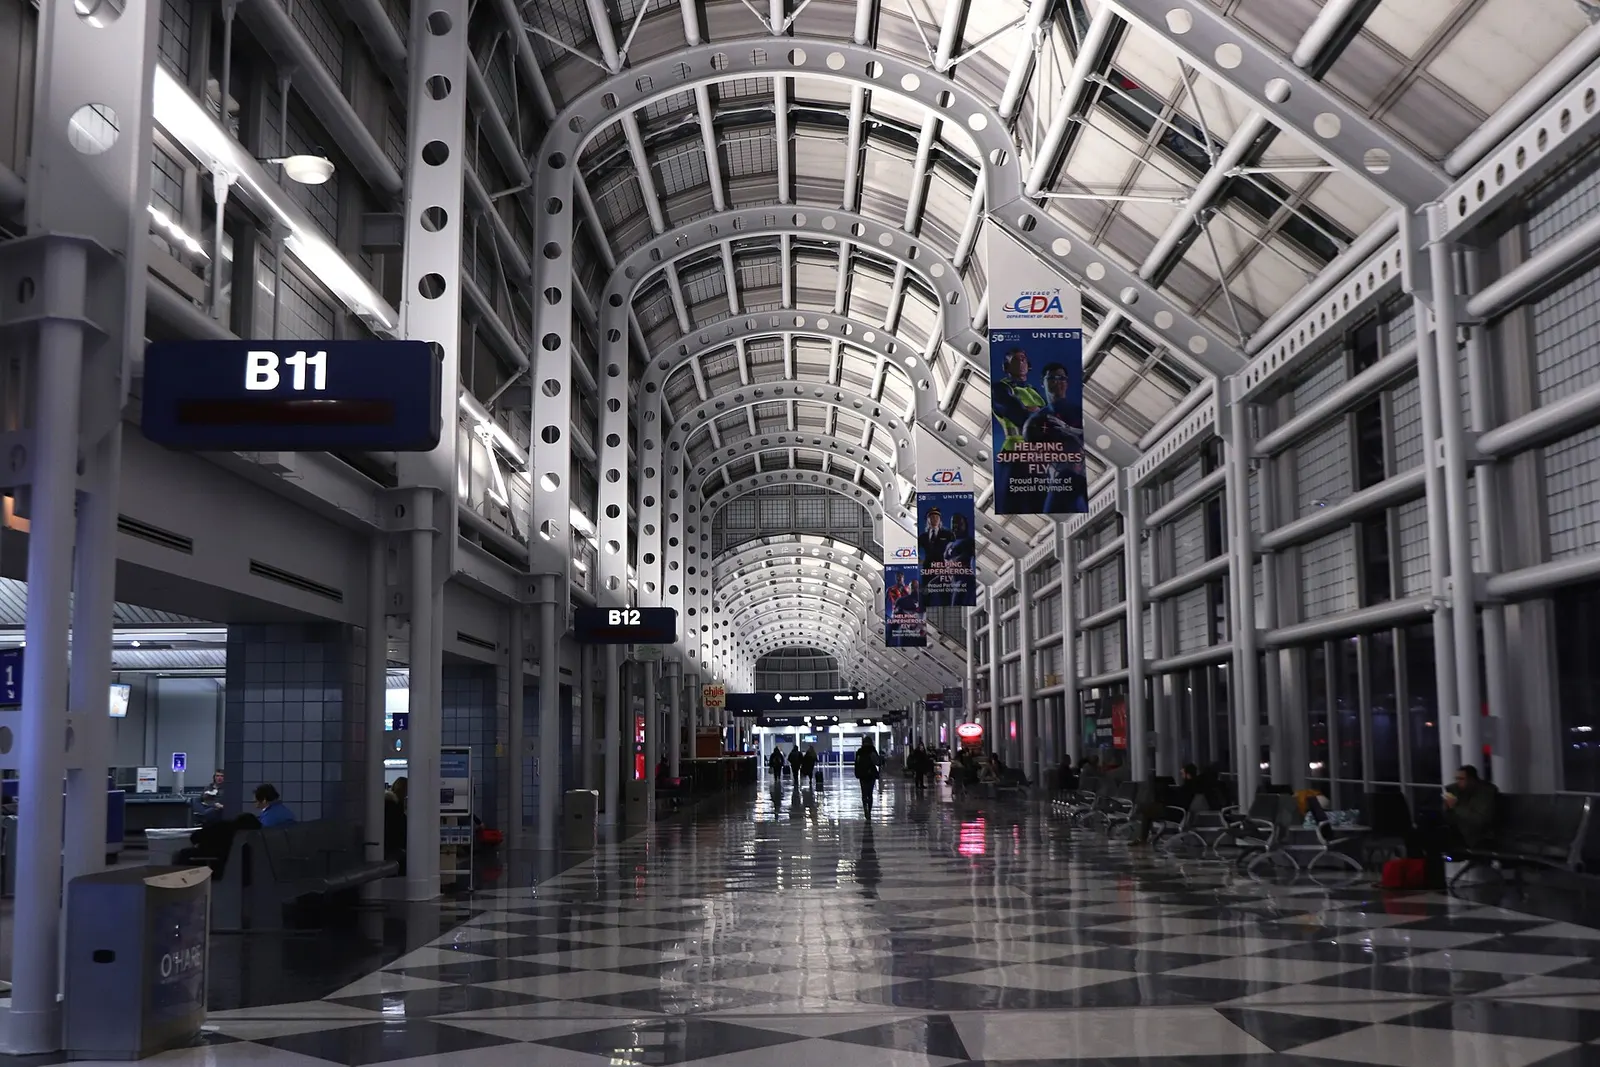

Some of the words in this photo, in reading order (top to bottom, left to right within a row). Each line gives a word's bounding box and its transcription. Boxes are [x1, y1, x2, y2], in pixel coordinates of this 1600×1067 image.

[1014, 296, 1063, 313] CDA
[992, 334, 1004, 342] 50
[244, 350, 328, 391] B11
[1014, 442, 1064, 451] HELPING
[996, 453, 1082, 462] SUPERHEROES
[1028, 464, 1050, 474] FLY
[932, 472, 962, 482] CDA
[895, 549, 918, 557] CDA
[608, 610, 641, 625] B12
[6, 665, 14, 686] 1
[704, 686, 724, 698] chili's
[706, 698, 722, 706] bar
[398, 718, 404, 726] 1
